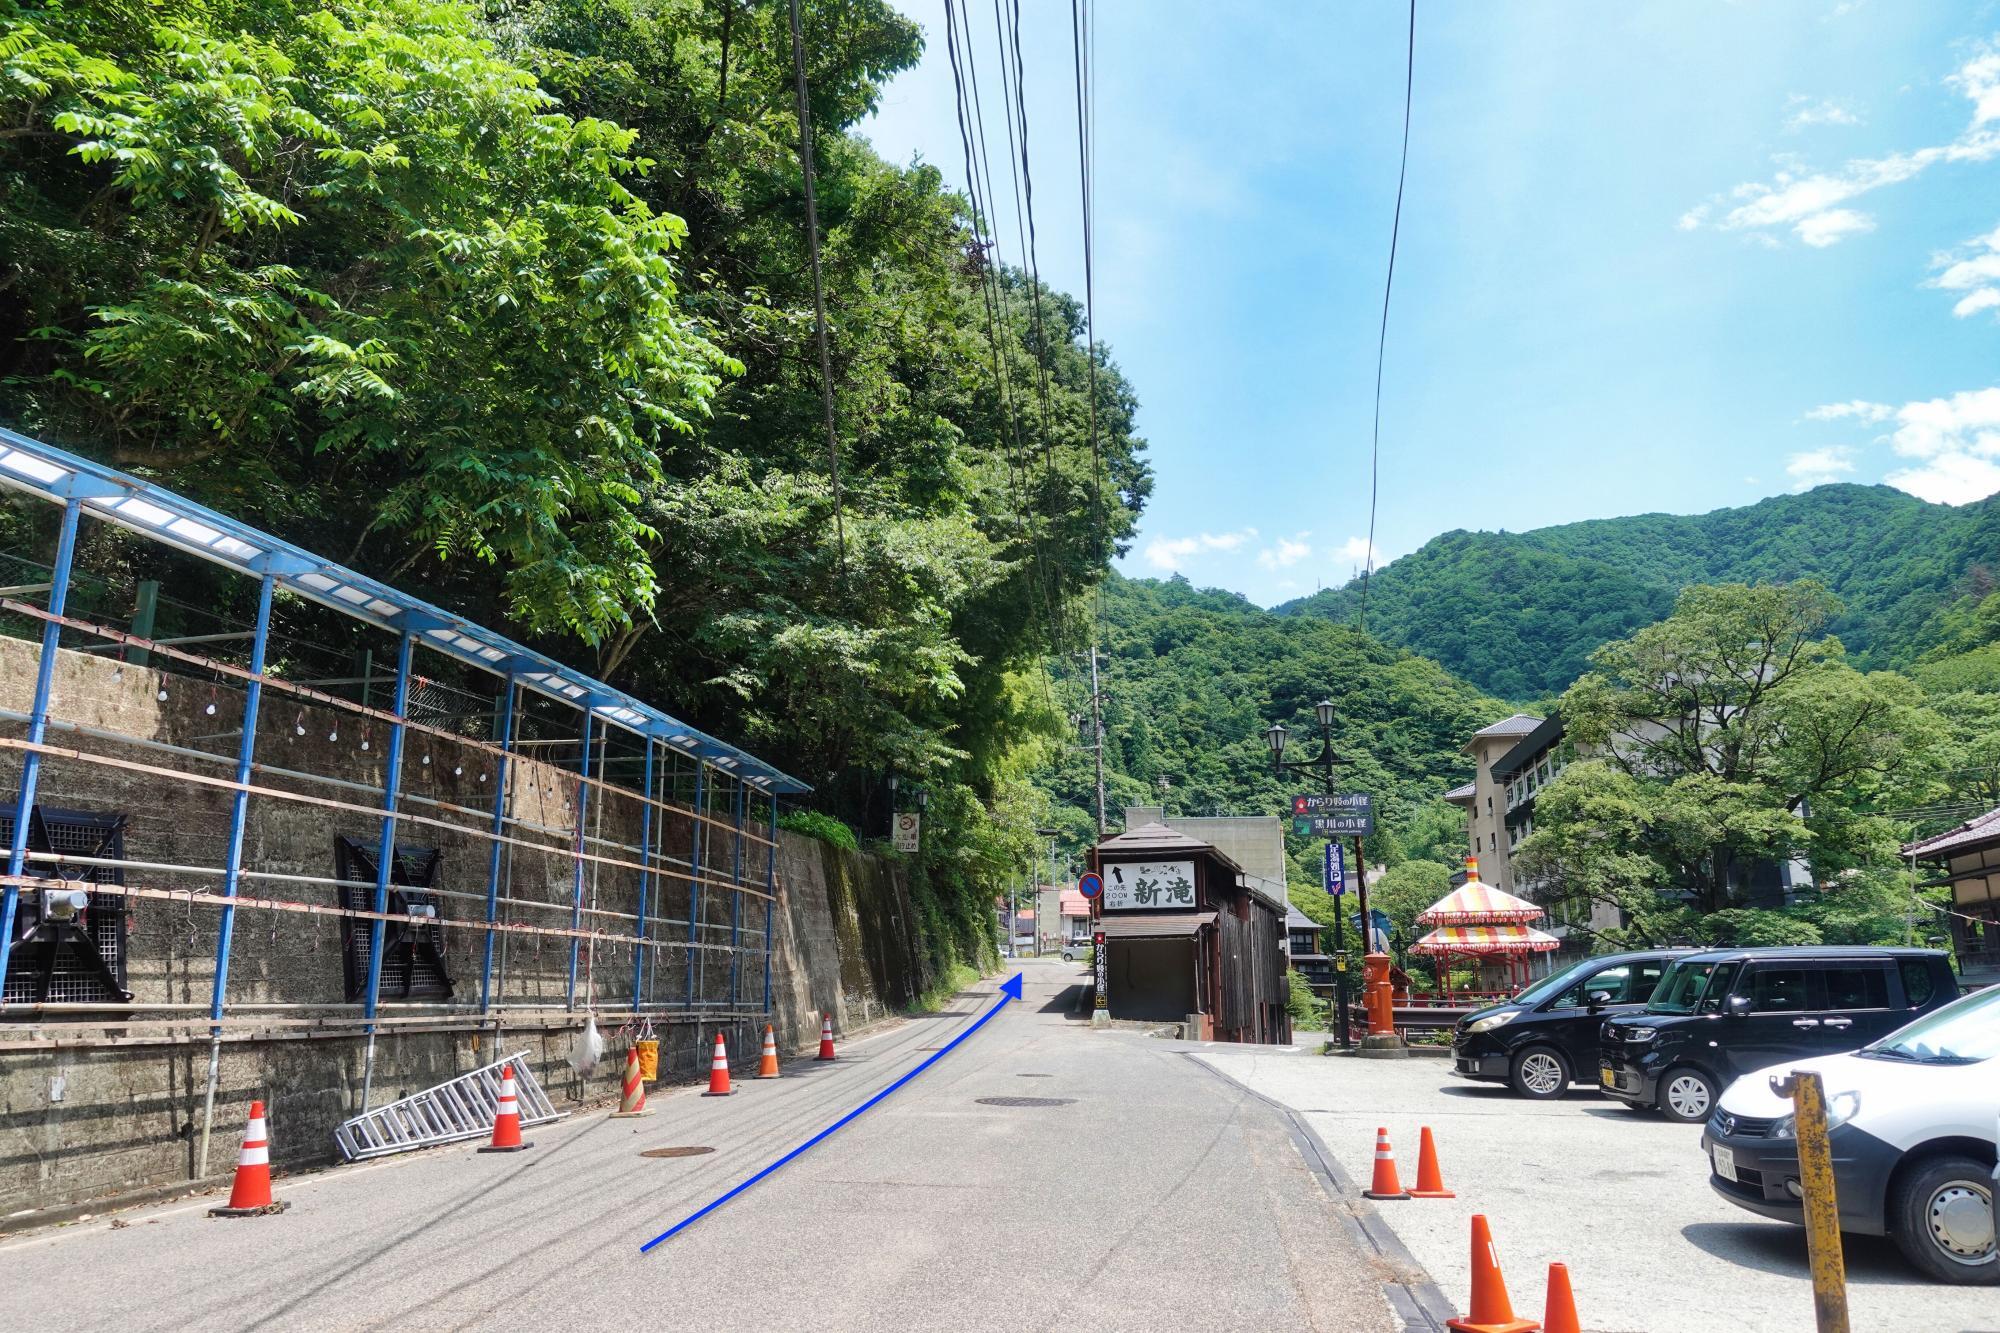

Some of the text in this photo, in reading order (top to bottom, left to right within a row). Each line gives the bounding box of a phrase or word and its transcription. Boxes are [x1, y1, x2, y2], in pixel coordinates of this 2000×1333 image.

[1315, 818, 1367, 829] 黒川の小径
[1134, 877, 1194, 906] 新滝
